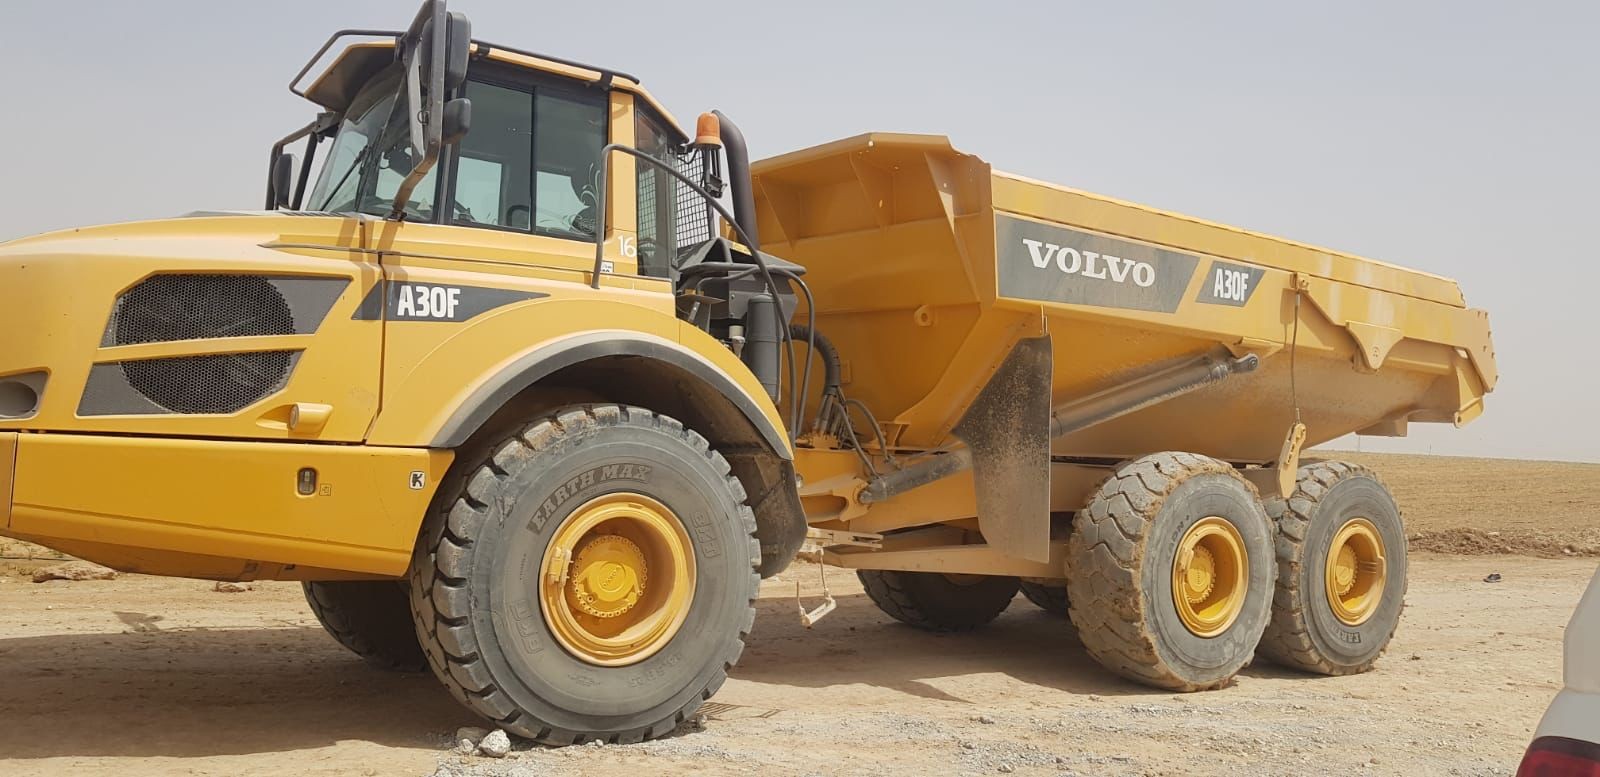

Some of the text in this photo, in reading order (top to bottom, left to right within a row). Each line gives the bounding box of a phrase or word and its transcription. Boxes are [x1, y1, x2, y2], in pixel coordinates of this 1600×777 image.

[617, 234, 637, 258] 16
[1022, 238, 1156, 287] VOLVO
[1213, 268, 1249, 301] A30F
[397, 285, 461, 318] A30F
[531, 463, 651, 532] EARTH MAX
